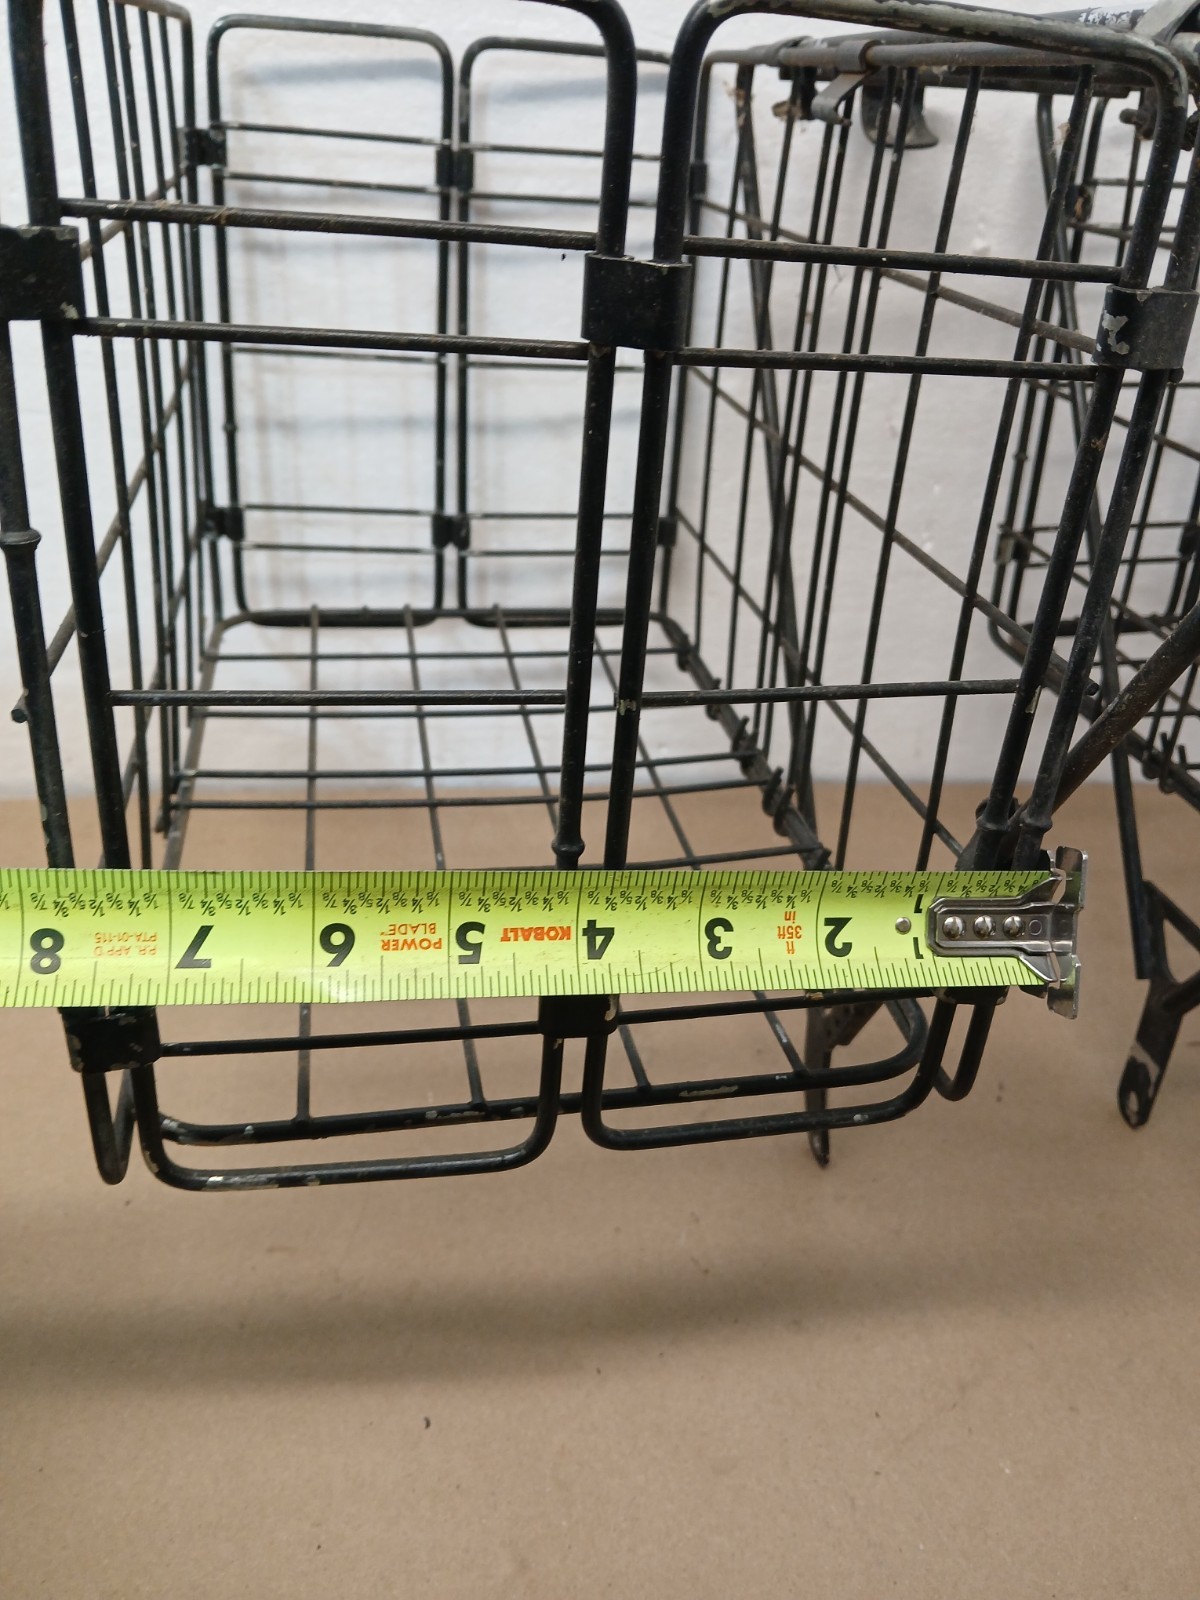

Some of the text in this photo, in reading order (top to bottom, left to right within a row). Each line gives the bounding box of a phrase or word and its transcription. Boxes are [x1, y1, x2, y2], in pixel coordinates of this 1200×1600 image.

[784, 911, 796, 923] in
[914, 894, 923, 914] 1
[175, 925, 214, 969] 7
[319, 922, 355, 967] 6
[381, 938, 442, 951] POWER
[456, 921, 486, 964] 5
[500, 926, 572, 942] KOBALT
[582, 920, 615, 960] 4
[704, 918, 734, 959] 3
[778, 926, 802, 939] 35ft
[786, 941, 795, 954] ft
[824, 917, 852, 958] 2
[912, 937, 924, 959] 1
[30, 928, 64, 974] 8
